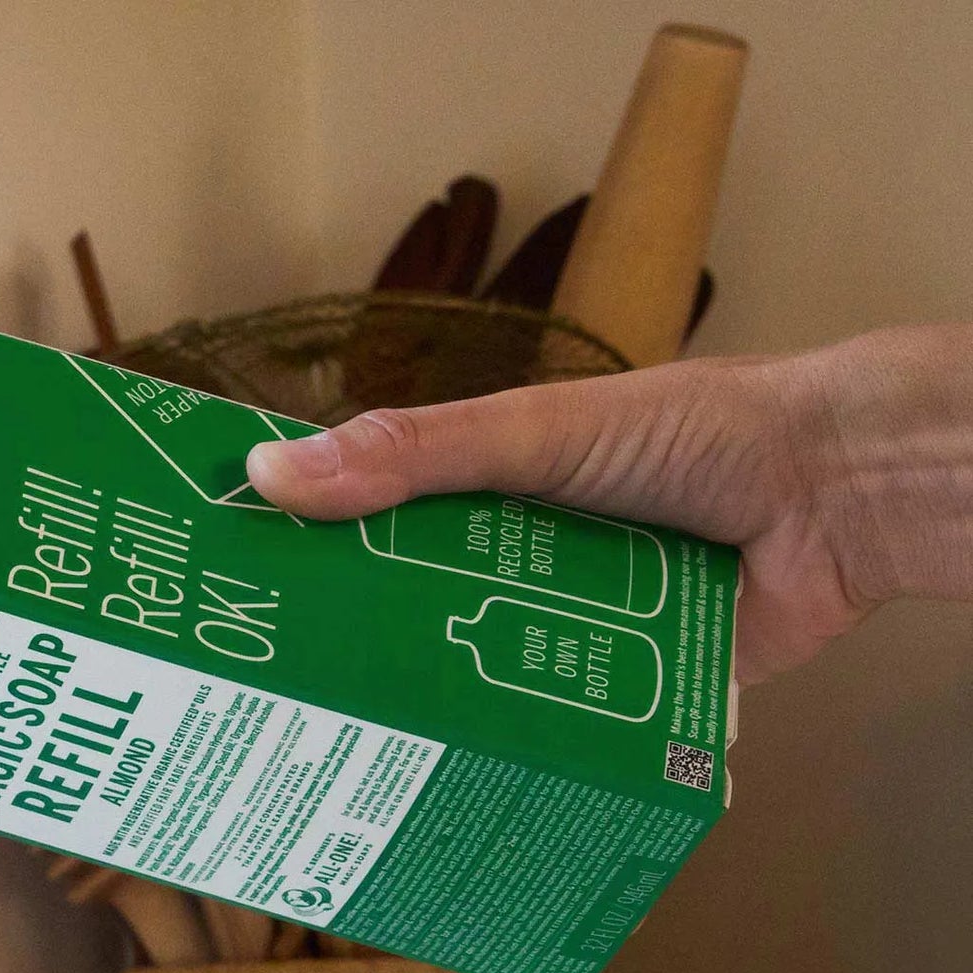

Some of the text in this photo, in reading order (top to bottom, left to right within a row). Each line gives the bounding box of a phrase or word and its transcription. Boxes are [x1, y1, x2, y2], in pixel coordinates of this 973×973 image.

[7, 467, 102, 610] Refill!
[100, 497, 193, 638] Refill!
[467, 509, 492, 554] 100%
[497, 500, 524, 577] RECYCLED
[530, 517, 555, 576] BOTTLE
[194, 570, 280, 662] OK!
[522, 625, 547, 671] YOUR
[555, 636, 579, 678] OWN
[585, 632, 613, 700] BOTTLE
[11, 686, 144, 823] REFILL
[99, 737, 156, 807] ALMOND
[113, 826, 130, 841] WITH
[122, 779, 159, 827] REGENERATIVE
[150, 747, 177, 780] ORGANIC
[193, 684, 211, 704] OILS
